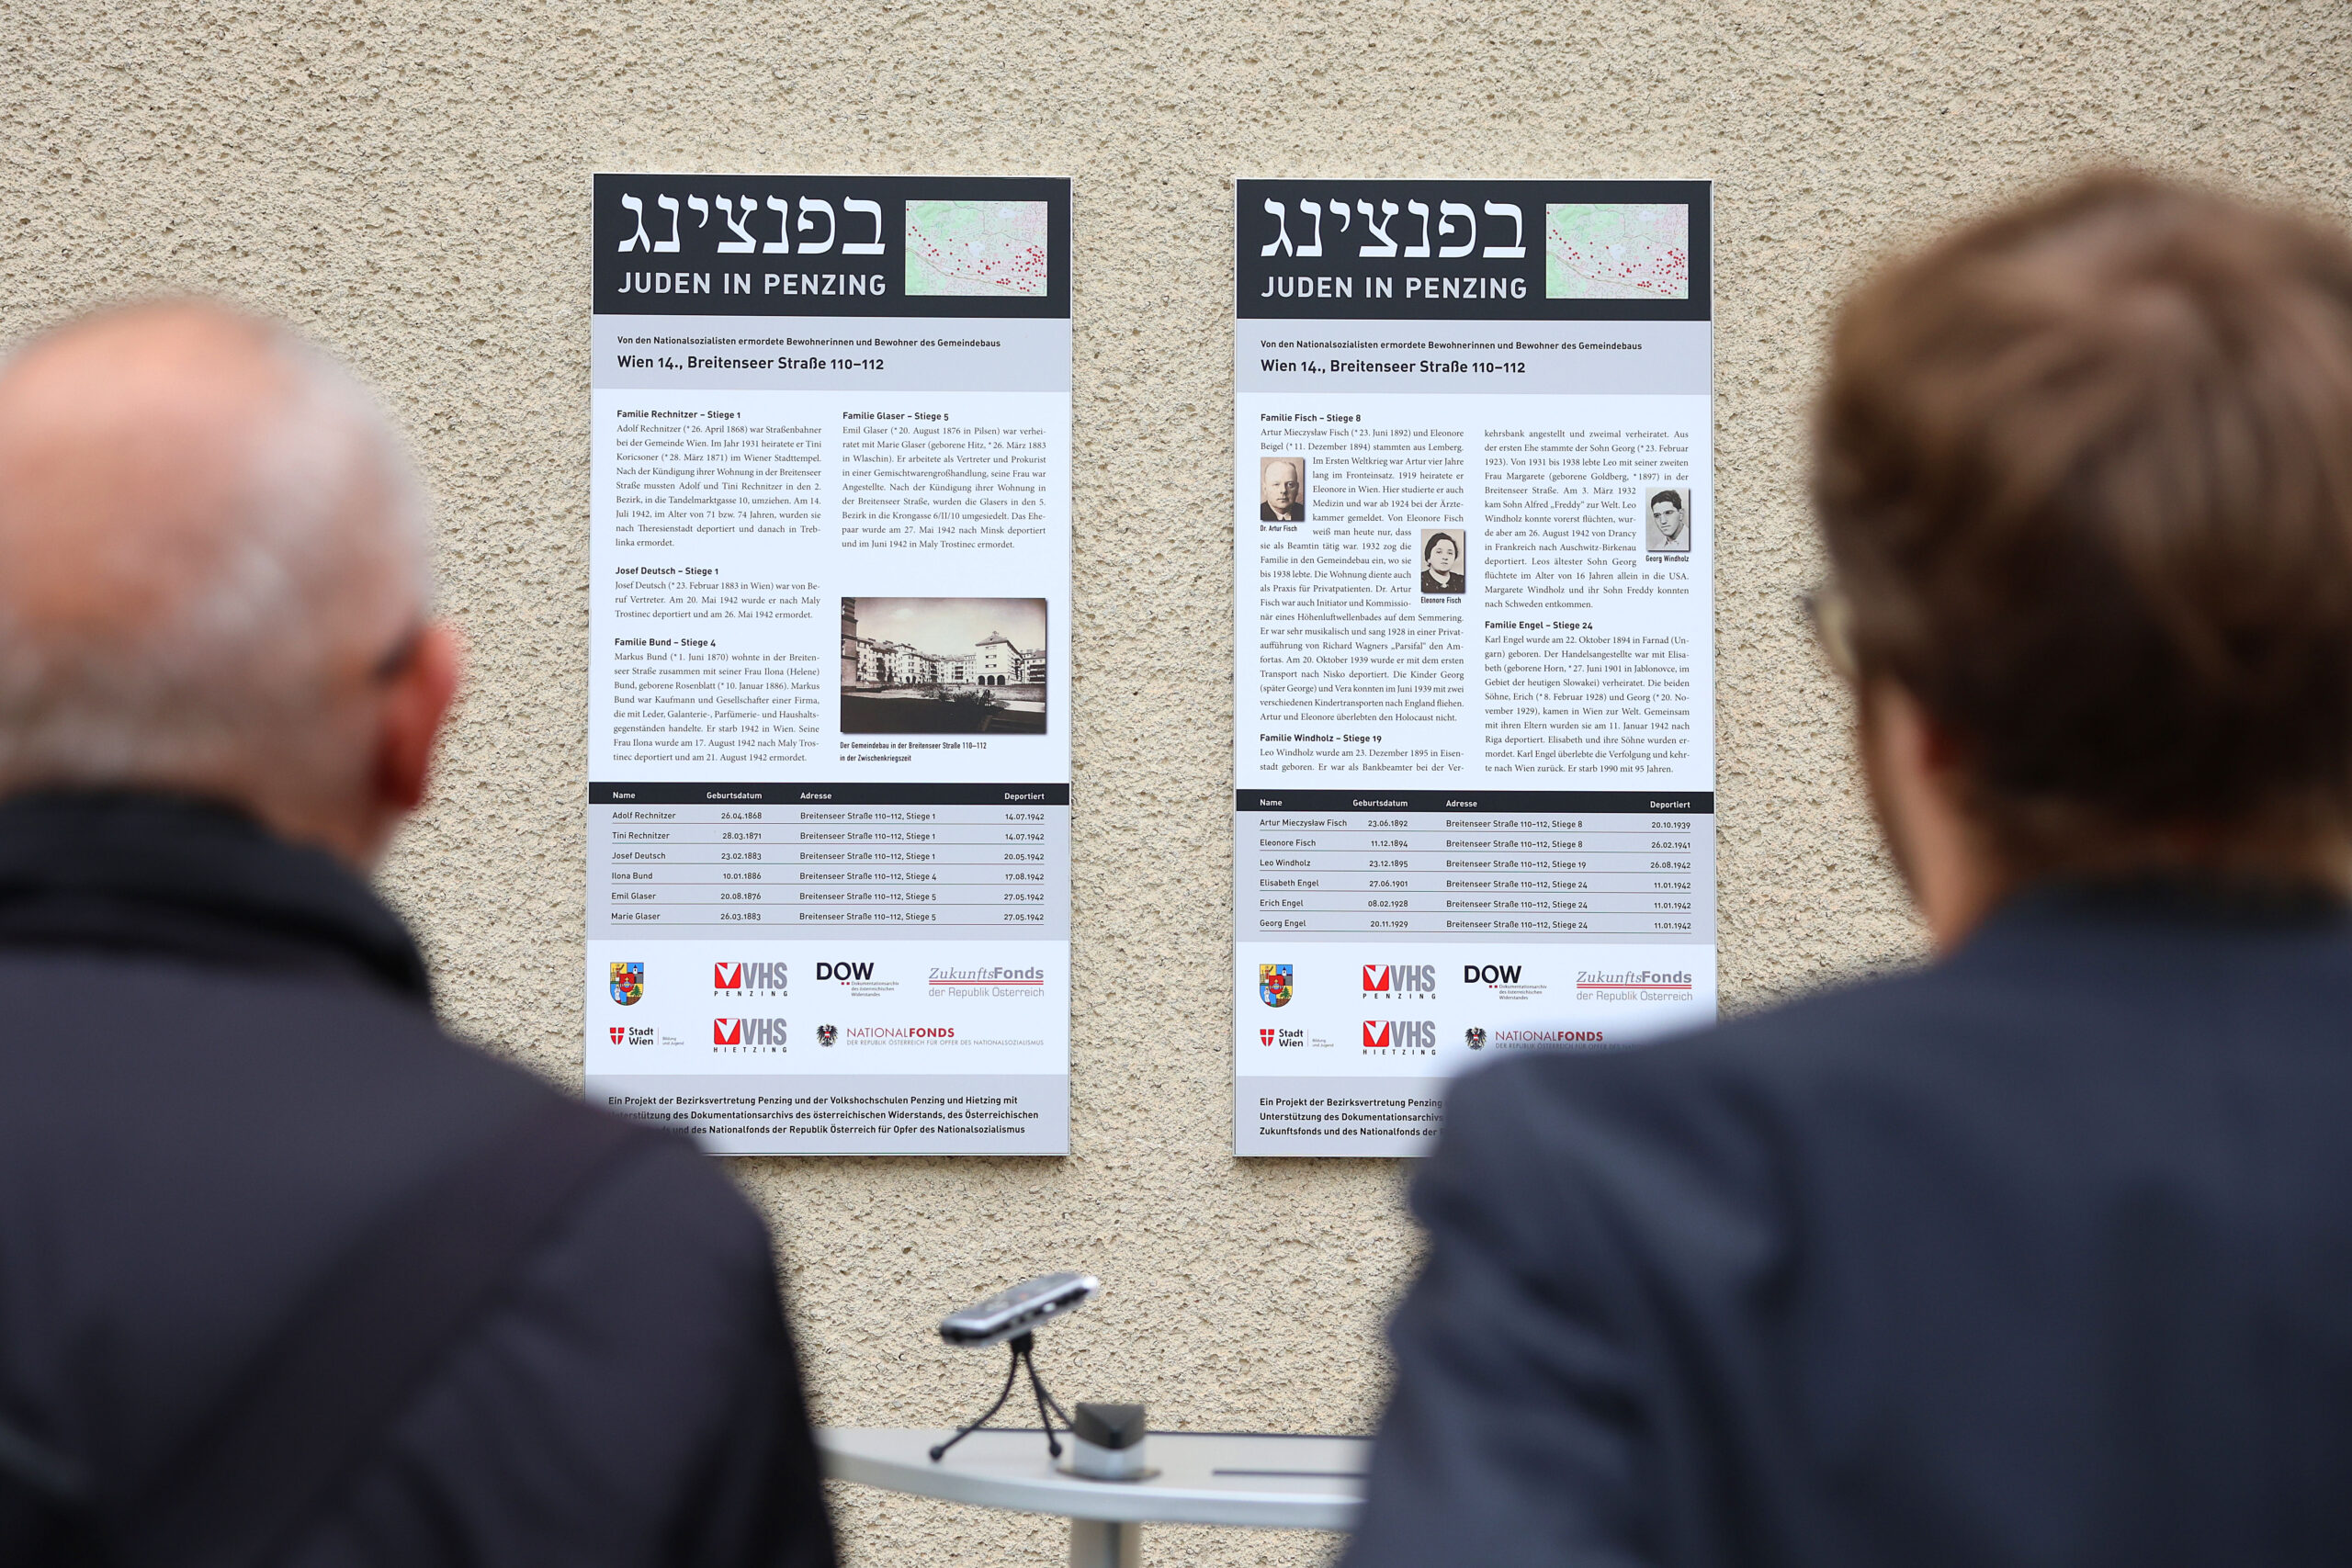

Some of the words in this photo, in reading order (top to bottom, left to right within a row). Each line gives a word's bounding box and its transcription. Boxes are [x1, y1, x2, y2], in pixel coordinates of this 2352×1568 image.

[617, 193, 886, 255] בפנצינג
[1261, 197, 1527, 258] בפנצינג
[617, 271, 710, 295] JUDEN
[724, 273, 751, 295] IN
[764, 273, 886, 296] PENZING
[1261, 276, 1352, 299] JUDEN
[1365, 276, 1393, 299] IN
[1406, 276, 1527, 299] PENZING
[616, 335, 634, 344] Von
[635, 335, 651, 344] den
[653, 335, 737, 345] Nationalsozialisten
[738, 337, 785, 345] ermordete
[786, 337, 854, 346] Bewohnerinnen
[855, 338, 873, 346] und
[874, 338, 919, 347] Bewohner
[920, 338, 936, 347] des
[937, 338, 1001, 347] Gemeindebaus
[1260, 340, 1277, 348] Von
[1278, 340, 1295, 348] den
[1296, 340, 1379, 349] Nationalsozialisten
[1380, 341, 1427, 349] ermordete
[1428, 341, 1496, 350] Bewohnerinnen
[1497, 341, 1514, 350] und
[1515, 341, 1560, 350] Bewohner
[1561, 342, 1577, 350] des
[1578, 341, 1643, 350] Gemeindebaus
[616, 355, 654, 368] Wien
[658, 356, 684, 371] 14.,
[687, 355, 775, 369] Breitenseer
[777, 356, 827, 370] Straße
[830, 358, 884, 370] 110–112
[1261, 358, 1296, 372] Wien
[1301, 360, 1326, 374] 14.,
[1330, 358, 1417, 373] Breitenseer
[1419, 359, 1468, 373] Straße
[1472, 361, 1526, 374] 110–112
[616, 409, 650, 418] Familie
[650, 410, 698, 419] Rechnitzer
[707, 410, 735, 421] Stiege
[842, 411, 875, 420] Familie
[876, 412, 906, 420] Glaser
[914, 412, 942, 423] Stiege
[944, 412, 949, 422] 5
[1261, 413, 1293, 422] Familie
[1295, 413, 1317, 422] Fisch
[1326, 413, 1354, 424] Stiege
[1355, 413, 1362, 423] 8
[616, 438, 628, 447] bei
[629, 438, 644, 447] der
[644, 438, 684, 447] Gemeinde
[685, 439, 709, 447] Wien.
[710, 439, 722, 447] Im
[723, 438, 740, 448] Jahr
[741, 439, 759, 447] 1931
[761, 439, 795, 448] heiratete
[805, 440, 822, 448] Tini
[1645, 554, 1663, 564] Georg
[1663, 554, 1690, 562] Windholz
[615, 566, 639, 575] Josef
[640, 566, 676, 575] Deutsch
[684, 567, 713, 577] Stiege
[1485, 620, 1517, 629] Familie
[1519, 620, 1544, 631] Engel
[1553, 620, 1580, 631] Stiege
[1581, 622, 1593, 630] 24
[614, 637, 647, 647] Familie
[649, 637, 672, 647] Bund
[681, 637, 708, 649] Stiege
[709, 638, 717, 648] 4
[1260, 733, 1293, 742] Familie
[1294, 733, 1334, 742] Windholz
[1342, 734, 1371, 744] Stiege
[1372, 735, 1383, 744] 19
[840, 741, 851, 750] Der
[851, 741, 889, 750] Gemeindebau
[890, 741, 897, 750] in
[897, 741, 908, 750] der
[908, 741, 942, 750] Breitenseer
[942, 741, 961, 750] Straße
[962, 741, 987, 750] 110–112
[612, 791, 636, 799] Name
[706, 791, 763, 799] Geburtsdatum
[799, 792, 832, 800] Adresse
[1004, 792, 1045, 802] Deportiert
[1260, 798, 1283, 807] Name
[1352, 799, 1408, 807] Geburtsdatum
[1445, 799, 1478, 807] Adresse
[1650, 800, 1690, 810] Deportiert
[612, 811, 633, 819] Adolf
[634, 811, 677, 819] Rechnitzer
[720, 811, 763, 820] 26.04.1868
[800, 811, 846, 820] Breitenseer
[847, 812, 874, 820] Straße
[875, 812, 905, 820] 110–112,
[906, 812, 931, 822] Stiege
[1005, 813, 1045, 821] 14.07.1942
[1259, 818, 1281, 827] Artur
[1282, 818, 1326, 829] Mieczysław
[1327, 818, 1348, 827] Fisch
[1260, 919, 1283, 929] Georg
[1283, 919, 1306, 929] Engel
[1370, 920, 1408, 929] 20.11.1929
[1446, 919, 1492, 929] Breitenseer
[1493, 919, 1520, 929] Straße
[1521, 920, 1551, 930] 110–112,
[1552, 920, 1577, 931] Stiege
[1577, 921, 1589, 930] 24
[1654, 922, 1691, 931] 11.01.1942
[741, 962, 788, 990] VHS
[928, 965, 1045, 983] ZukunftsFonds
[1576, 970, 1692, 987] ZukunftsFonds
[928, 987, 946, 998] der
[948, 987, 990, 999] Republik
[991, 986, 1045, 998] Österreich
[628, 1026, 654, 1036] Stadt
[740, 1018, 787, 1046] VHS
[846, 1027, 955, 1038] NATIONALFONDS
[628, 1036, 654, 1046] Wien
[607, 1096, 623, 1106] Ein
[626, 1096, 657, 1109] Projekt
[658, 1096, 674, 1105] der
[675, 1096, 756, 1107] Bezirksvertretung
[758, 1096, 793, 1107] Penzing
[794, 1096, 811, 1105] und
[812, 1096, 829, 1105] der
[830, 1096, 909, 1105] Volkshochschulen
[910, 1096, 945, 1106] Penzing
[946, 1096, 964, 1104] und
[966, 1096, 1001, 1106] Hietzing
[1003, 1095, 1018, 1104] mit
[1260, 1097, 1274, 1106] Ein
[1275, 1097, 1307, 1109] Projekt
[1309, 1098, 1325, 1107] der
[1327, 1098, 1406, 1109] Bezirksvertretung
[1408, 1098, 1443, 1110] Penzing
